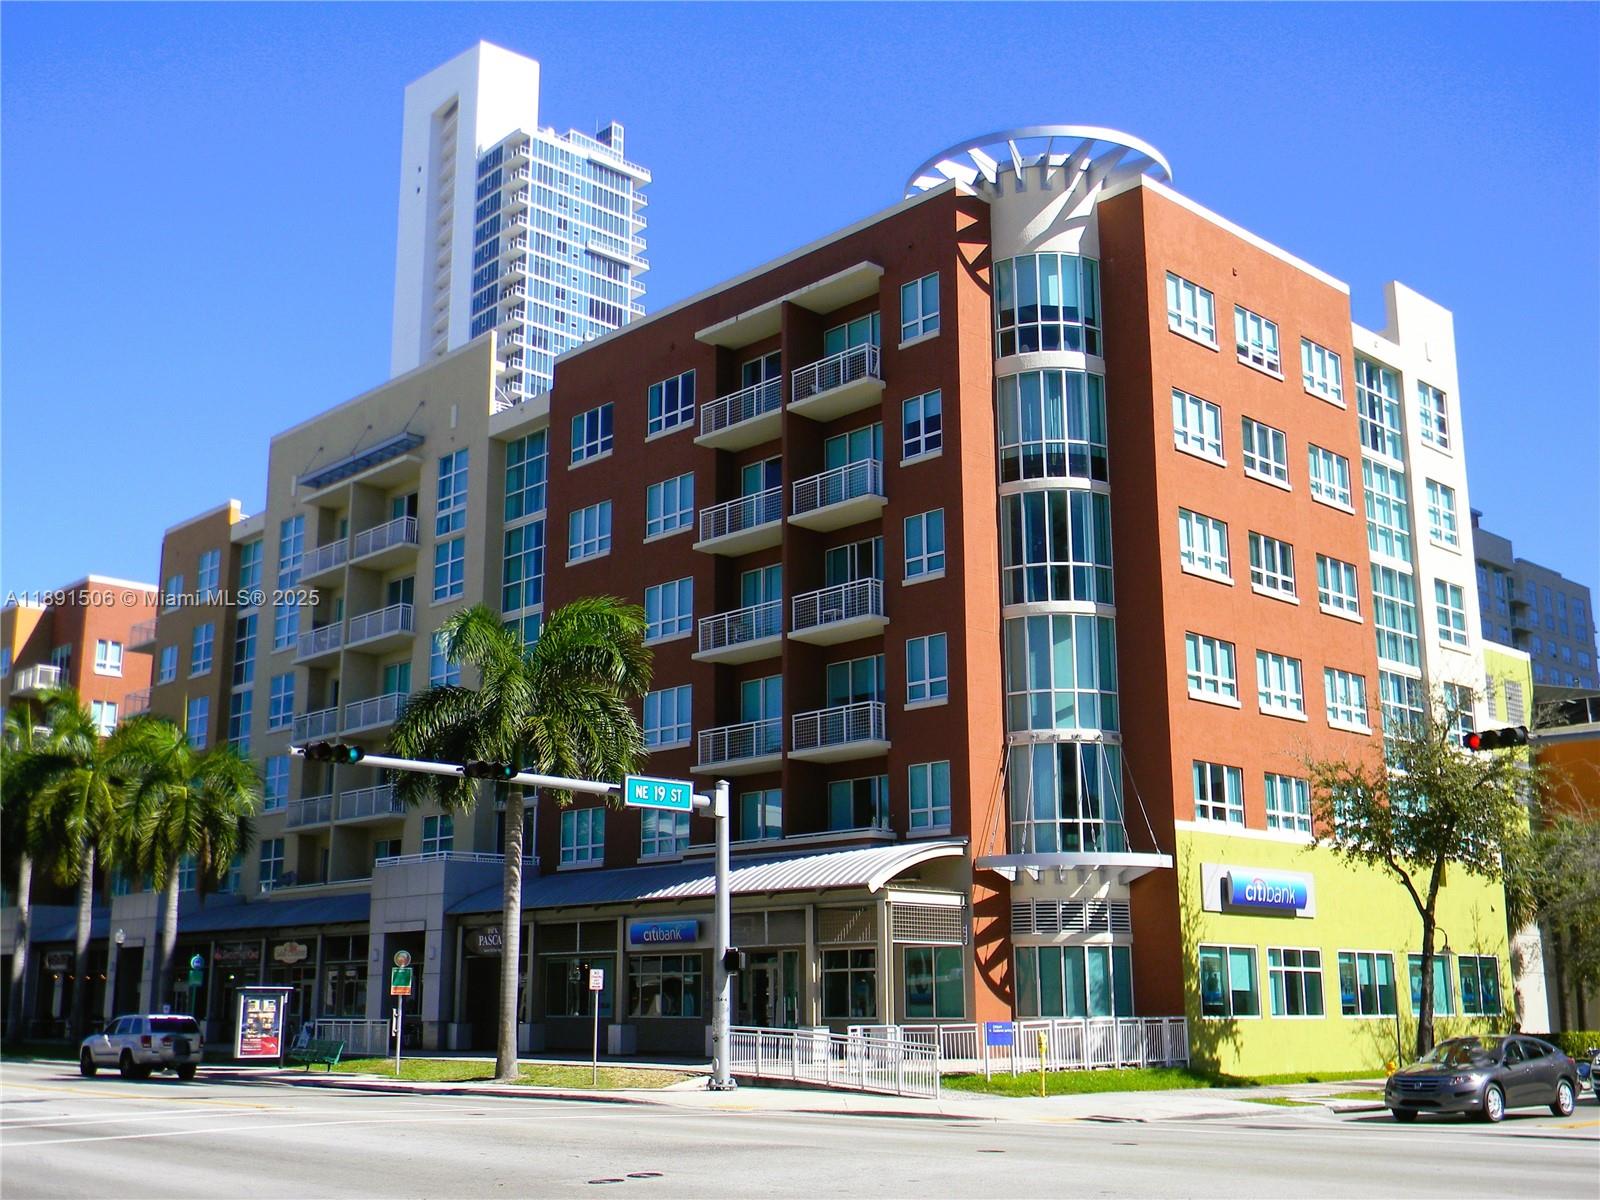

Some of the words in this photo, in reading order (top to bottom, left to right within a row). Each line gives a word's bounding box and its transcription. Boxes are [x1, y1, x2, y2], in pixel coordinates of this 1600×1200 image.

[635, 785, 649, 800] NE
[654, 786, 666, 801] 19
[671, 788, 683, 802] ST
[1245, 879, 1296, 905] citibank
[478, 934, 503, 946] PASCA
[643, 926, 682, 942] citibank
